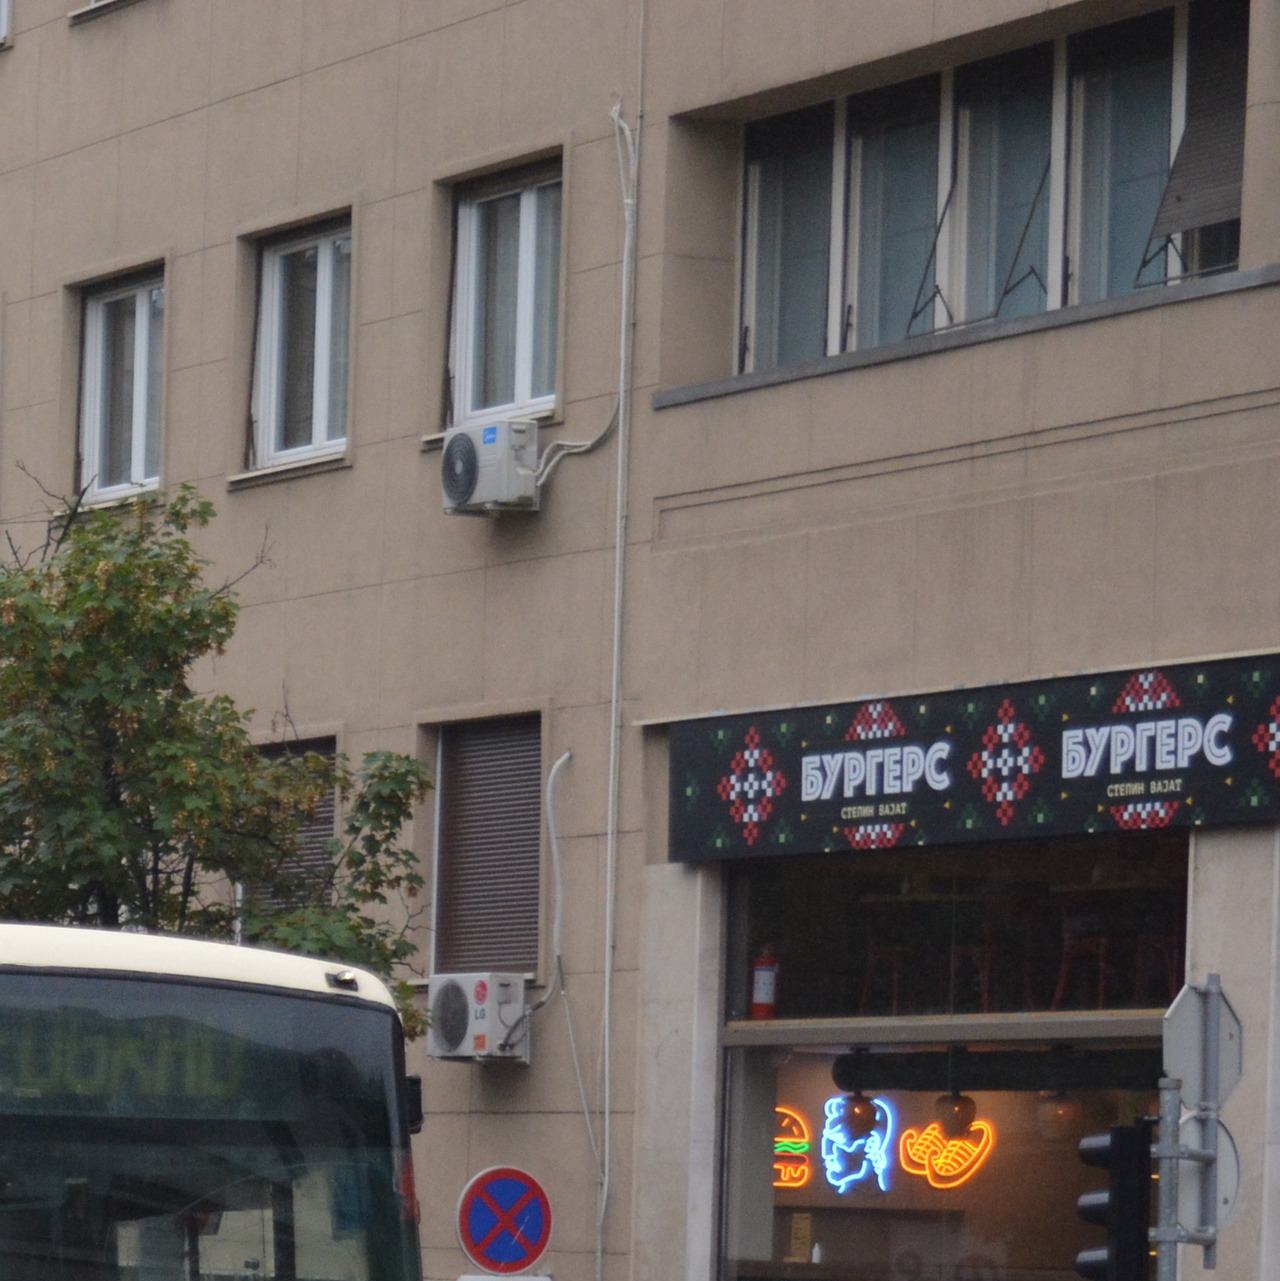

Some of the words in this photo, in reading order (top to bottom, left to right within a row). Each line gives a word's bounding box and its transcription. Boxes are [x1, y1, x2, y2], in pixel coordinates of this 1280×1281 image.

[1061, 713, 1233, 778] БУРГЕРС
[801, 741, 951, 801] БУРГЕРС
[1107, 783, 1145, 797] СТЕПИН
[841, 805, 874, 819] СТЕПИН
[475, 1008, 486, 1020] LG
